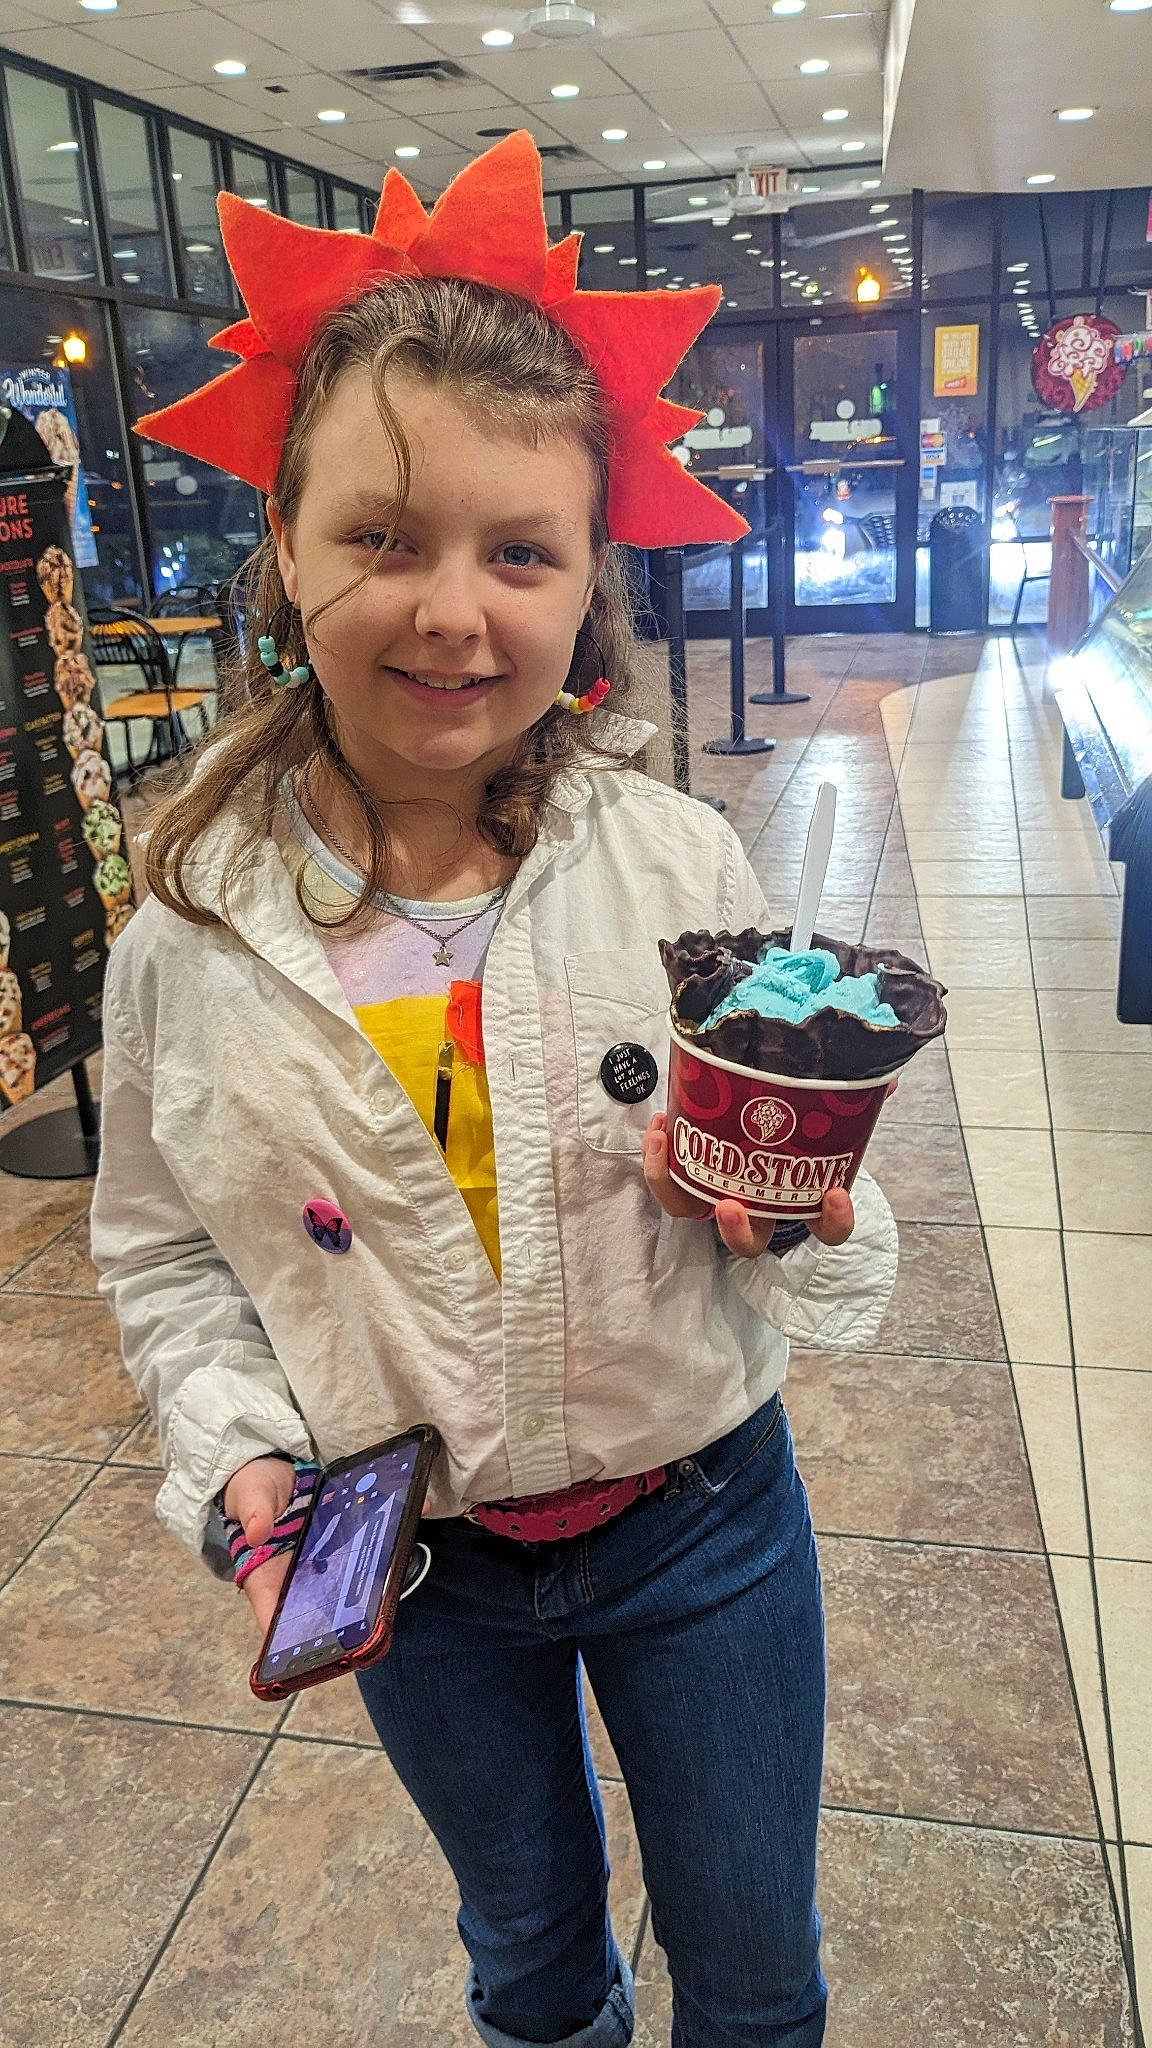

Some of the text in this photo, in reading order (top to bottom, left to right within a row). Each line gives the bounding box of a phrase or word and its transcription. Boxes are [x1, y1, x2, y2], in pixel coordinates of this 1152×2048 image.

[750, 172, 780, 196] XIT
[616, 1048, 630, 1062] JUST
[612, 1060, 631, 1074] HAVE
[614, 1067, 635, 1084] LOT OF
[619, 1070, 651, 1092] FEELINGS
[636, 1084, 647, 1095] OK
[673, 1116, 854, 1190] COLD STONE
[692, 1164, 815, 1202] CREAMERY
